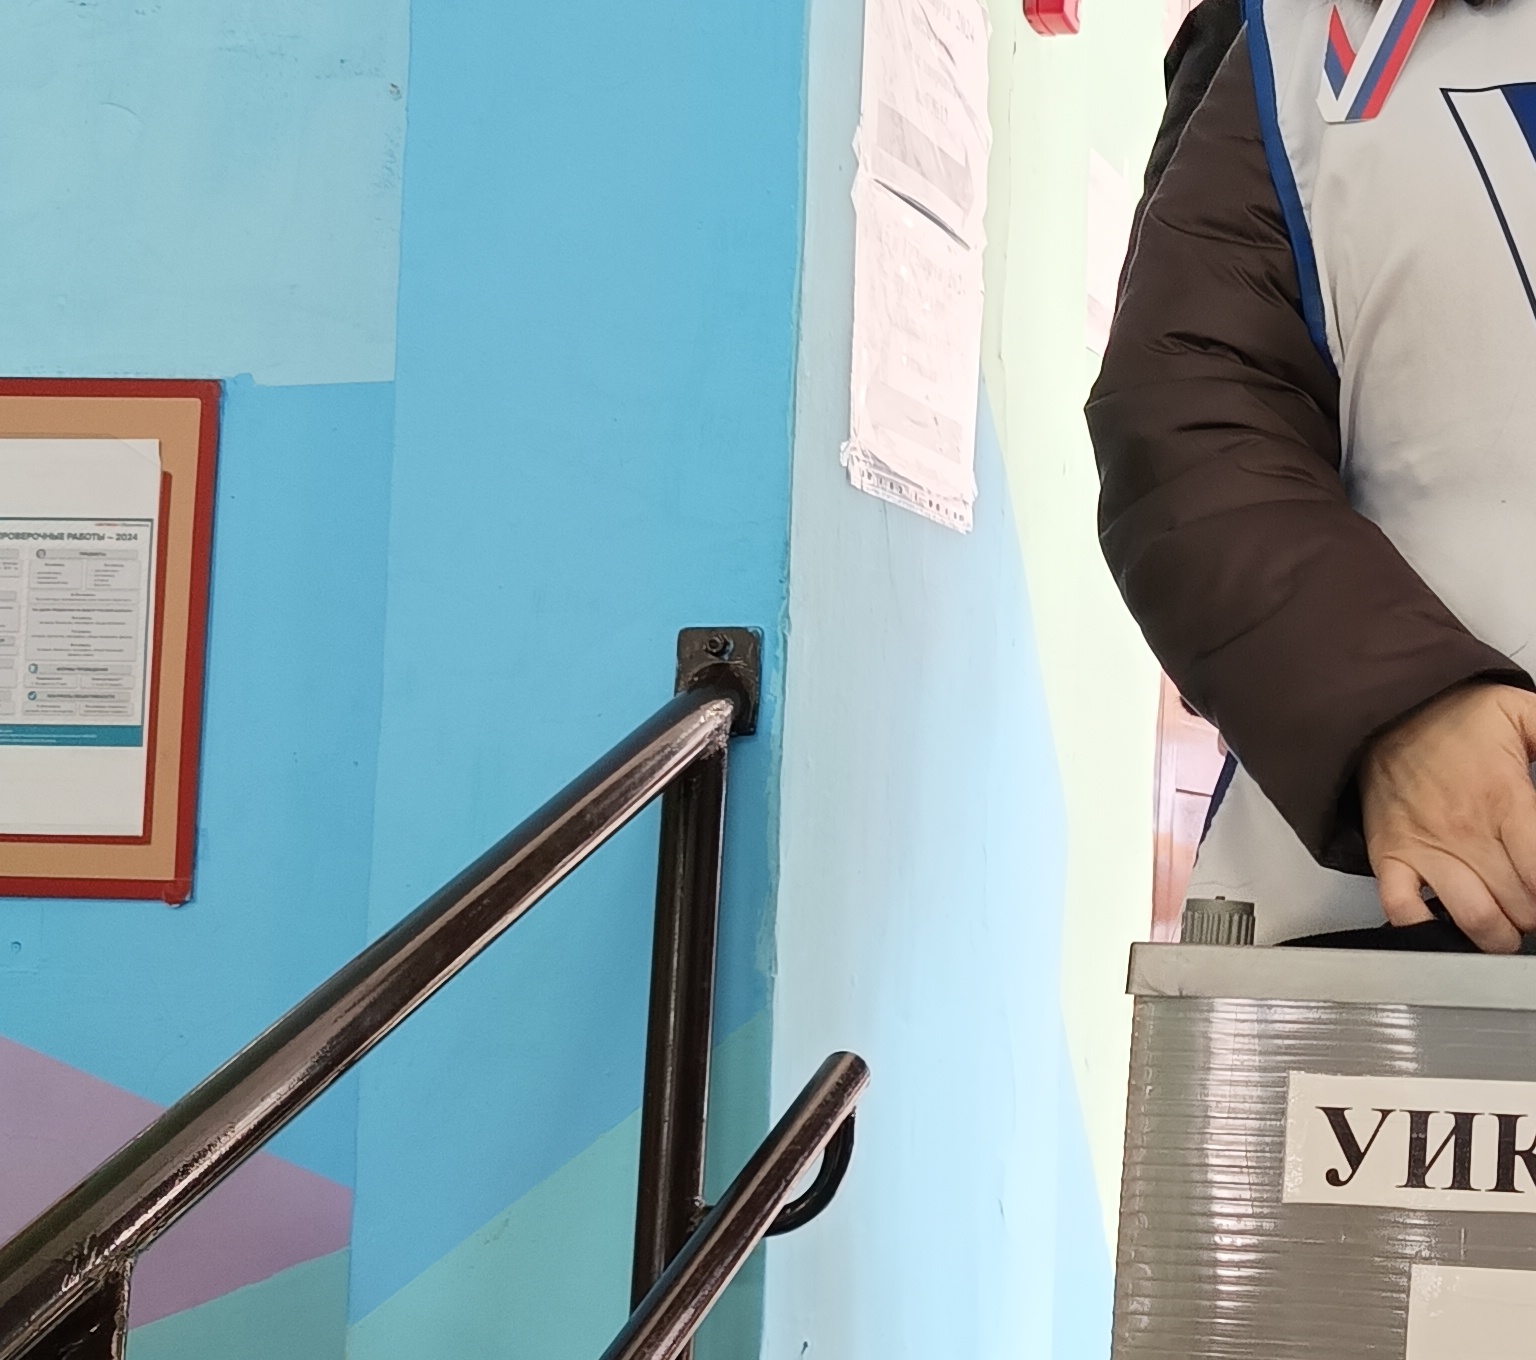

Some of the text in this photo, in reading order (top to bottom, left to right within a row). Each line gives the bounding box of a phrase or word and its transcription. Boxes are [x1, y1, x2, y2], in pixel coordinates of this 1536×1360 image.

[0, 532, 64, 541] РОВЕРОЧНЫЕ
[66, 532, 105, 541] РАБОТЫ
[115, 533, 138, 541] 2024
